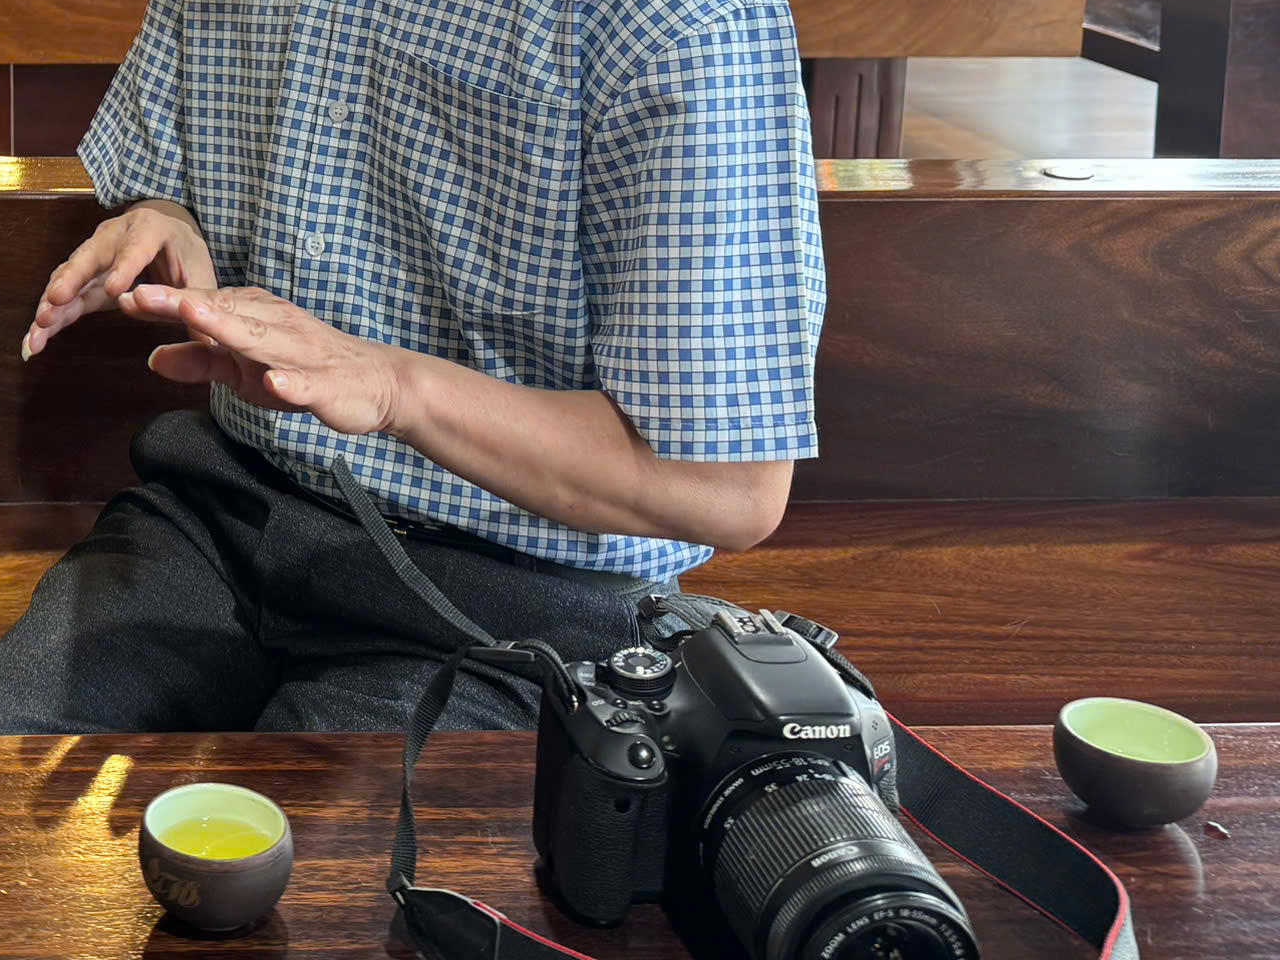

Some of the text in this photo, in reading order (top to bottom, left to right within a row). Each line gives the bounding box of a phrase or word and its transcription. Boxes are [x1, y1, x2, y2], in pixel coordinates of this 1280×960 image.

[782, 722, 852, 740] Canon
[872, 740, 891, 760] EOS
[751, 757, 808, 777] 18-55mm
[810, 845, 860, 868] Canon
[821, 932, 846, 960] ZOOM
[846, 916, 870, 934] LENS
